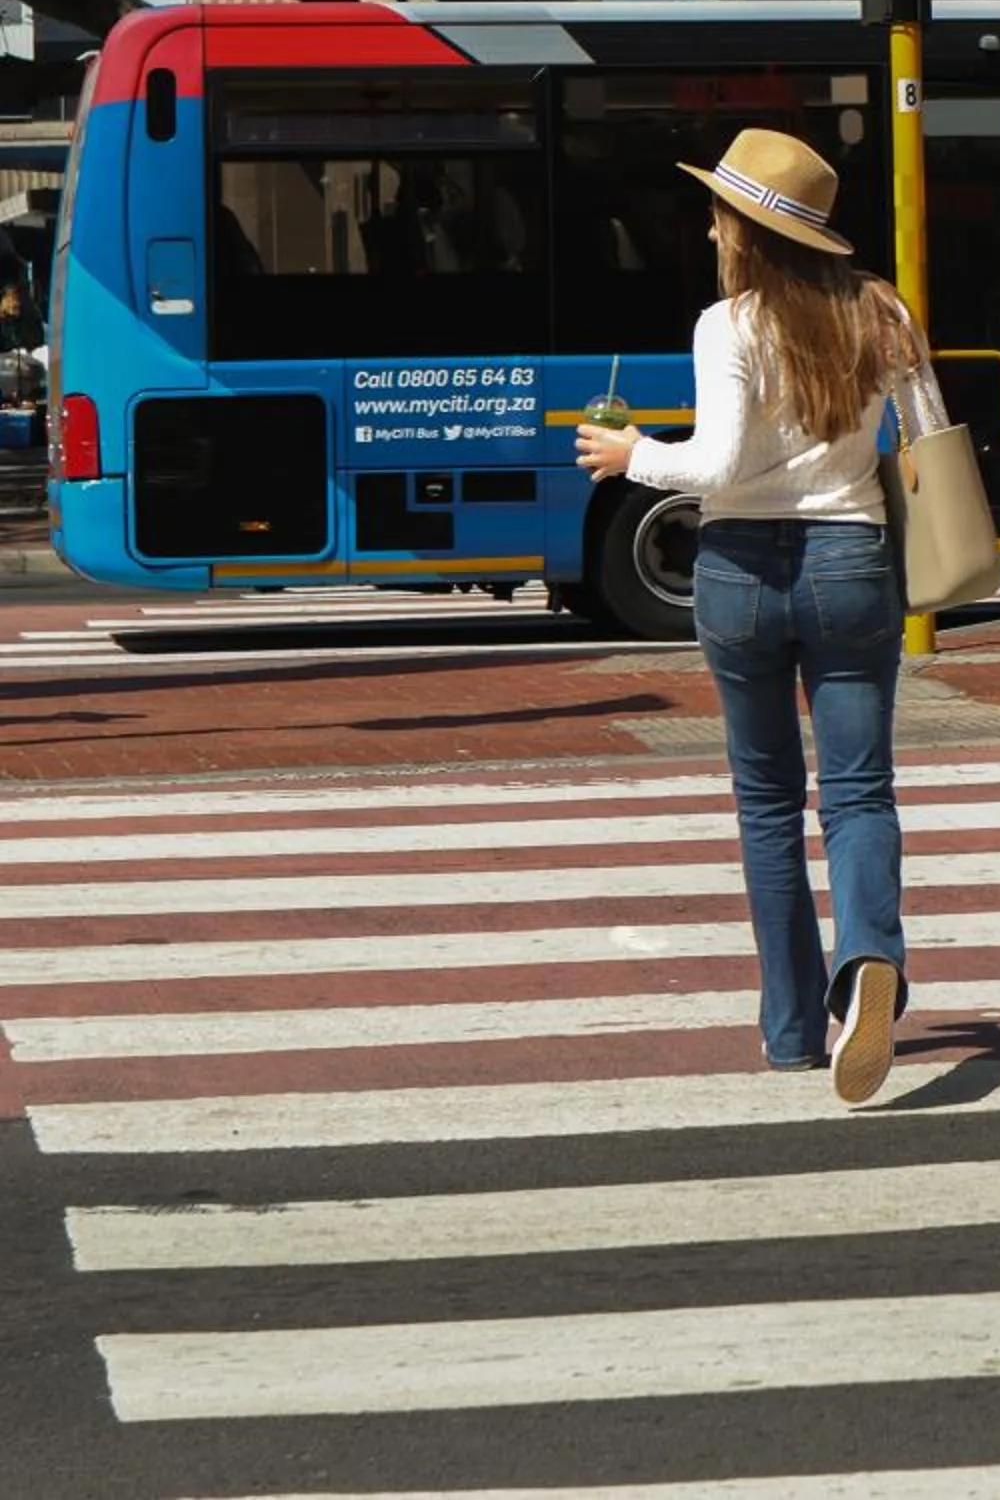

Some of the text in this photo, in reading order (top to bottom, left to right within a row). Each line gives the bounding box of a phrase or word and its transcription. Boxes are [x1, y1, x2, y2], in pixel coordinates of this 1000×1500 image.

[905, 83, 917, 106] 8
[354, 368, 535, 388] Call 0800 65 64 63
[354, 395, 536, 417] www.myciti.org.za
[416, 426, 439, 439] Bus
